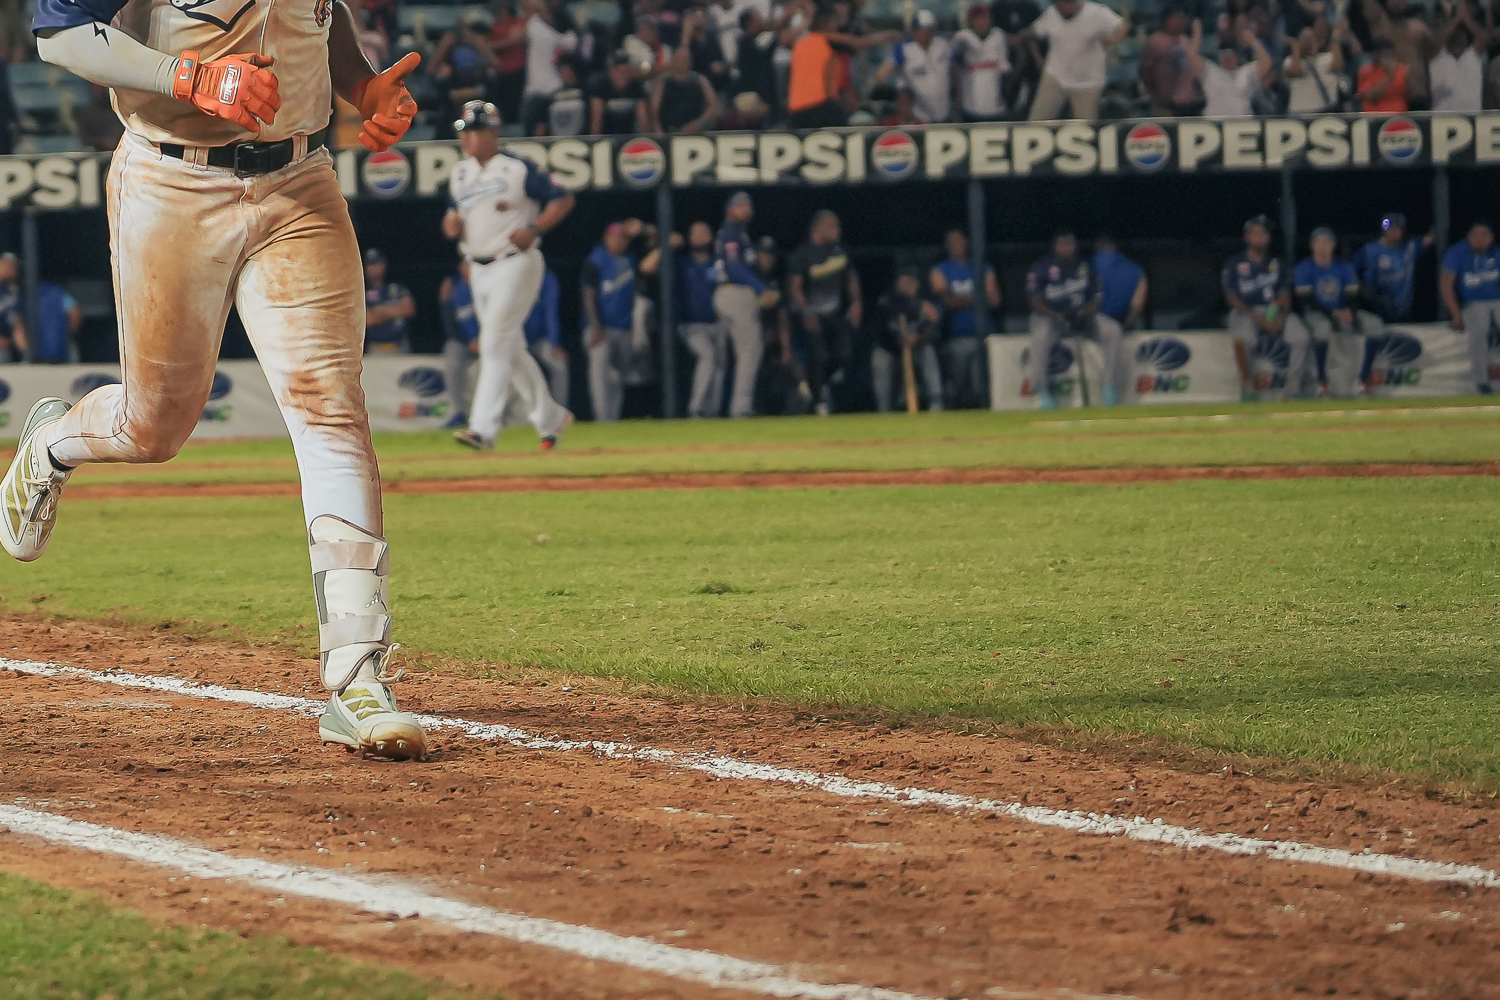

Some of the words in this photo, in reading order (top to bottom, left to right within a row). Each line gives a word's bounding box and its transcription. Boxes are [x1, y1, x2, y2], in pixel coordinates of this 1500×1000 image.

[670, 130, 867, 186] PEPSI
[923, 121, 1118, 180] PEPSI
[1177, 116, 1372, 172] PEPSI
